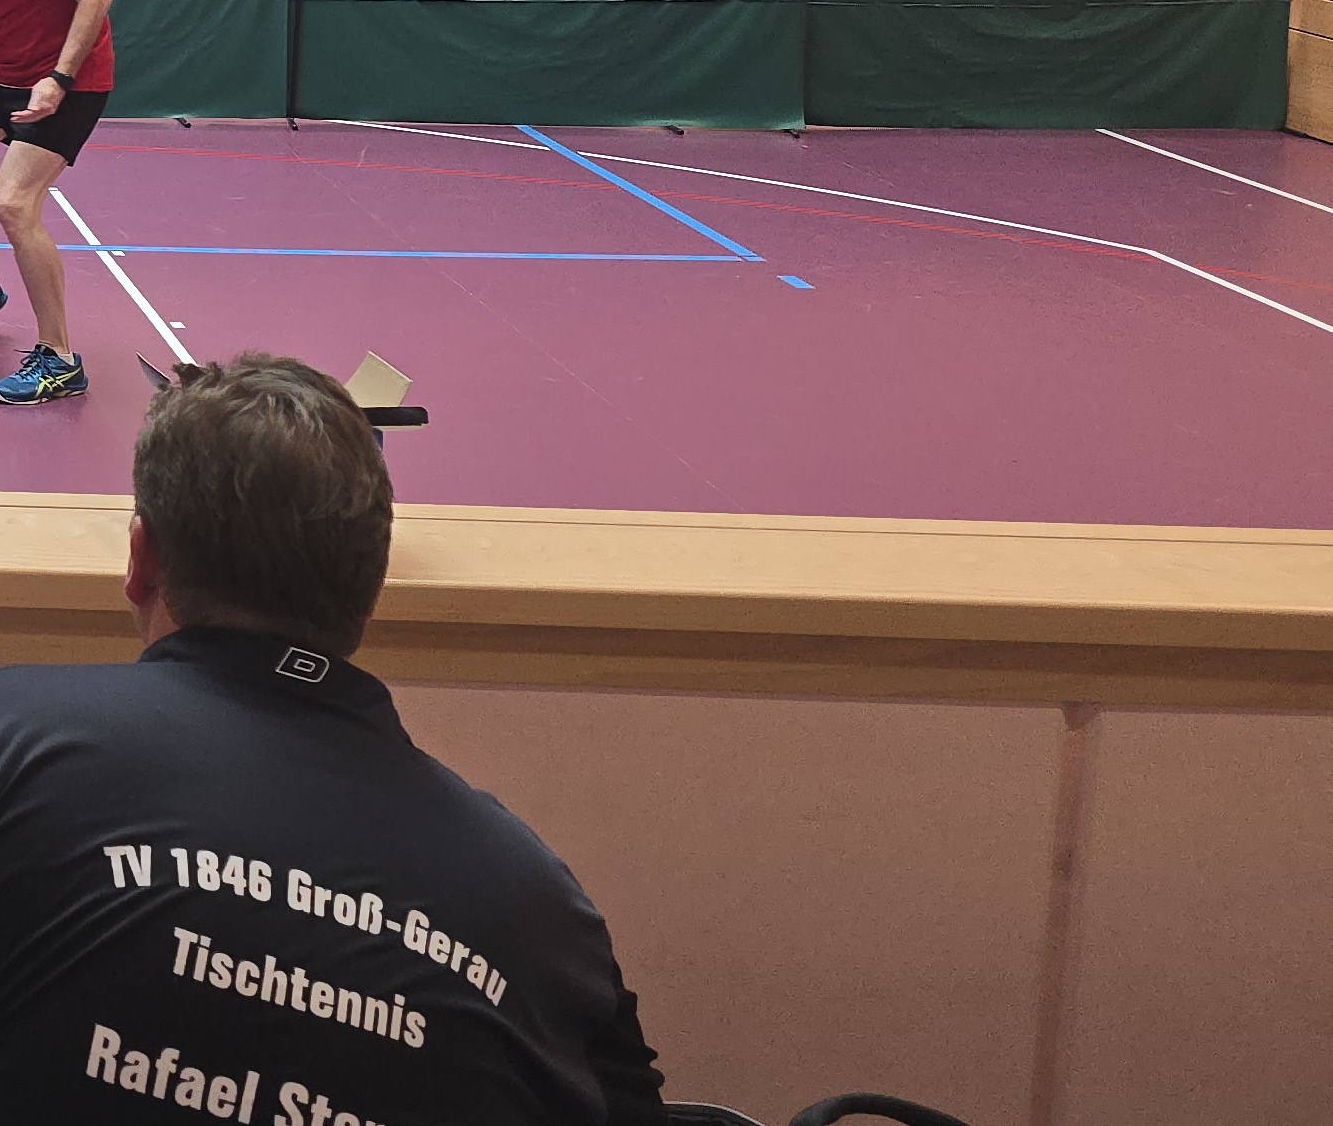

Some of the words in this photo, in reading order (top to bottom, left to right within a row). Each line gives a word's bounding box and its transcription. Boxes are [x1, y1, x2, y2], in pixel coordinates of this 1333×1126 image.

[103, 844, 153, 889] TV
[170, 847, 273, 903] 1846
[286, 868, 508, 1007] Groß-Gerau
[172, 926, 427, 1049] Tischtennis
[85, 1022, 261, 1126] Rafael
